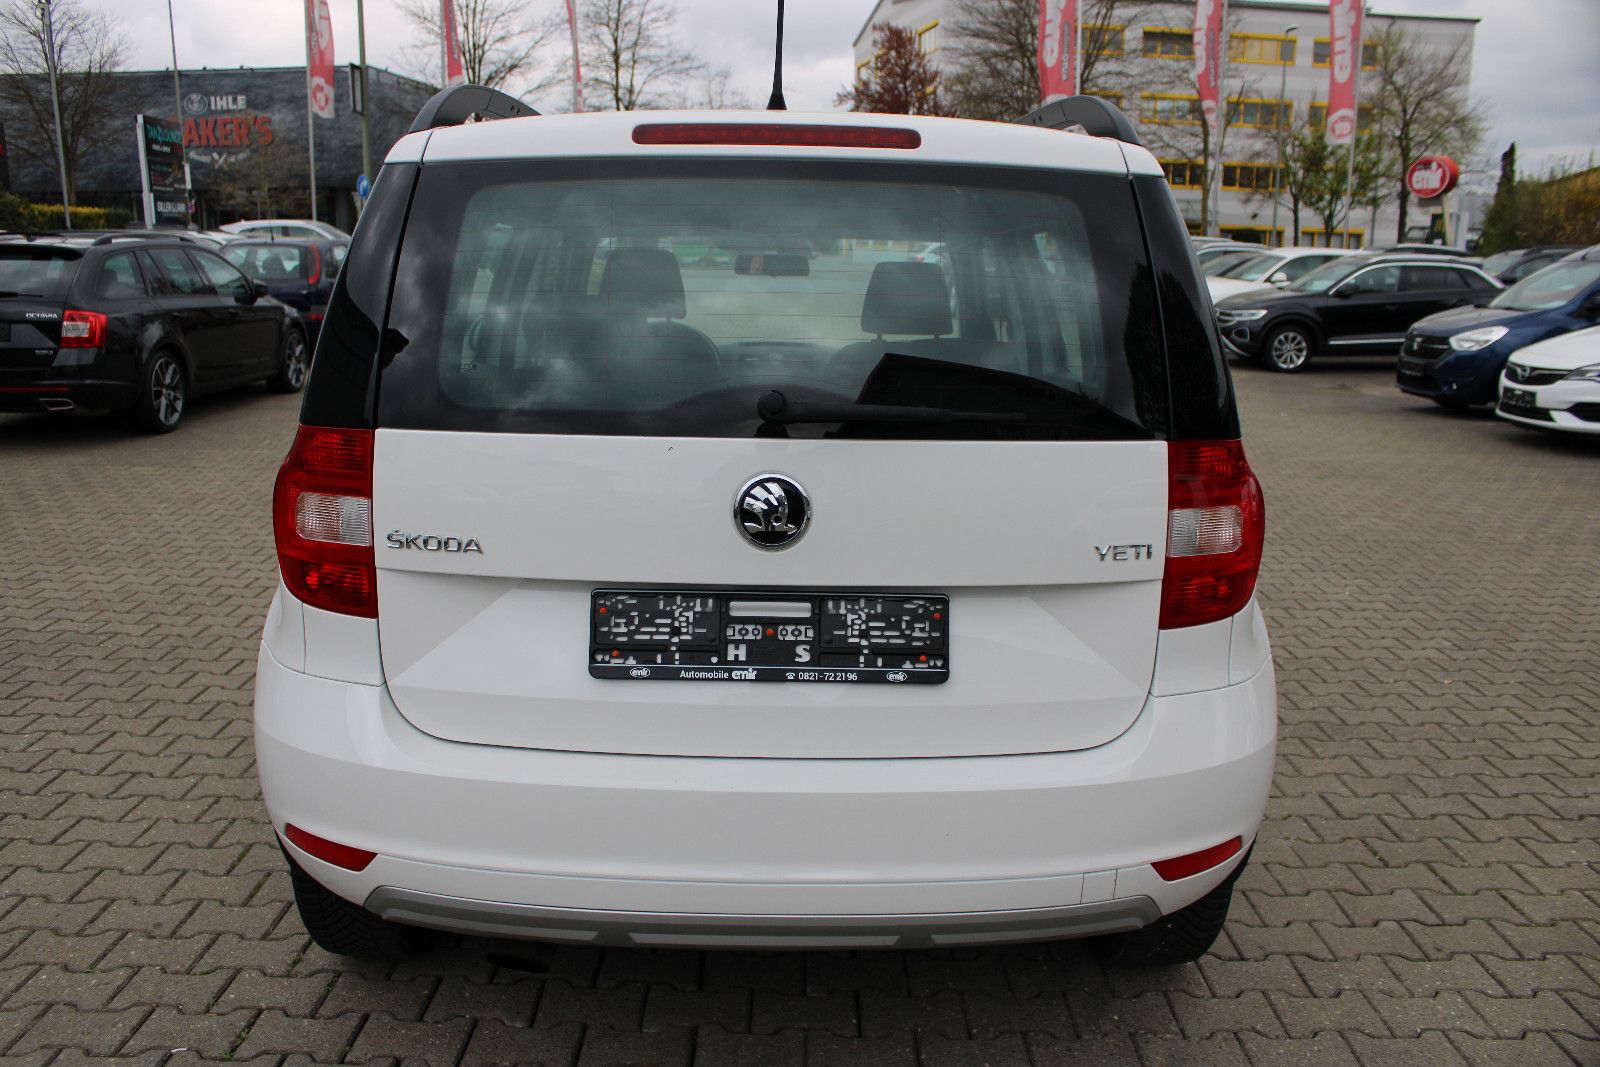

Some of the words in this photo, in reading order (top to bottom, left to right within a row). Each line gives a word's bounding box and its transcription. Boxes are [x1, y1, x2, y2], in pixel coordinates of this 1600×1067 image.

[210, 95, 247, 111] IHLE
[182, 116, 273, 147] AKER'S
[386, 529, 484, 554] ŠKODA
[1094, 544, 1153, 561] YETI
[680, 670, 729, 680] Automobile
[732, 667, 757, 680] emir
